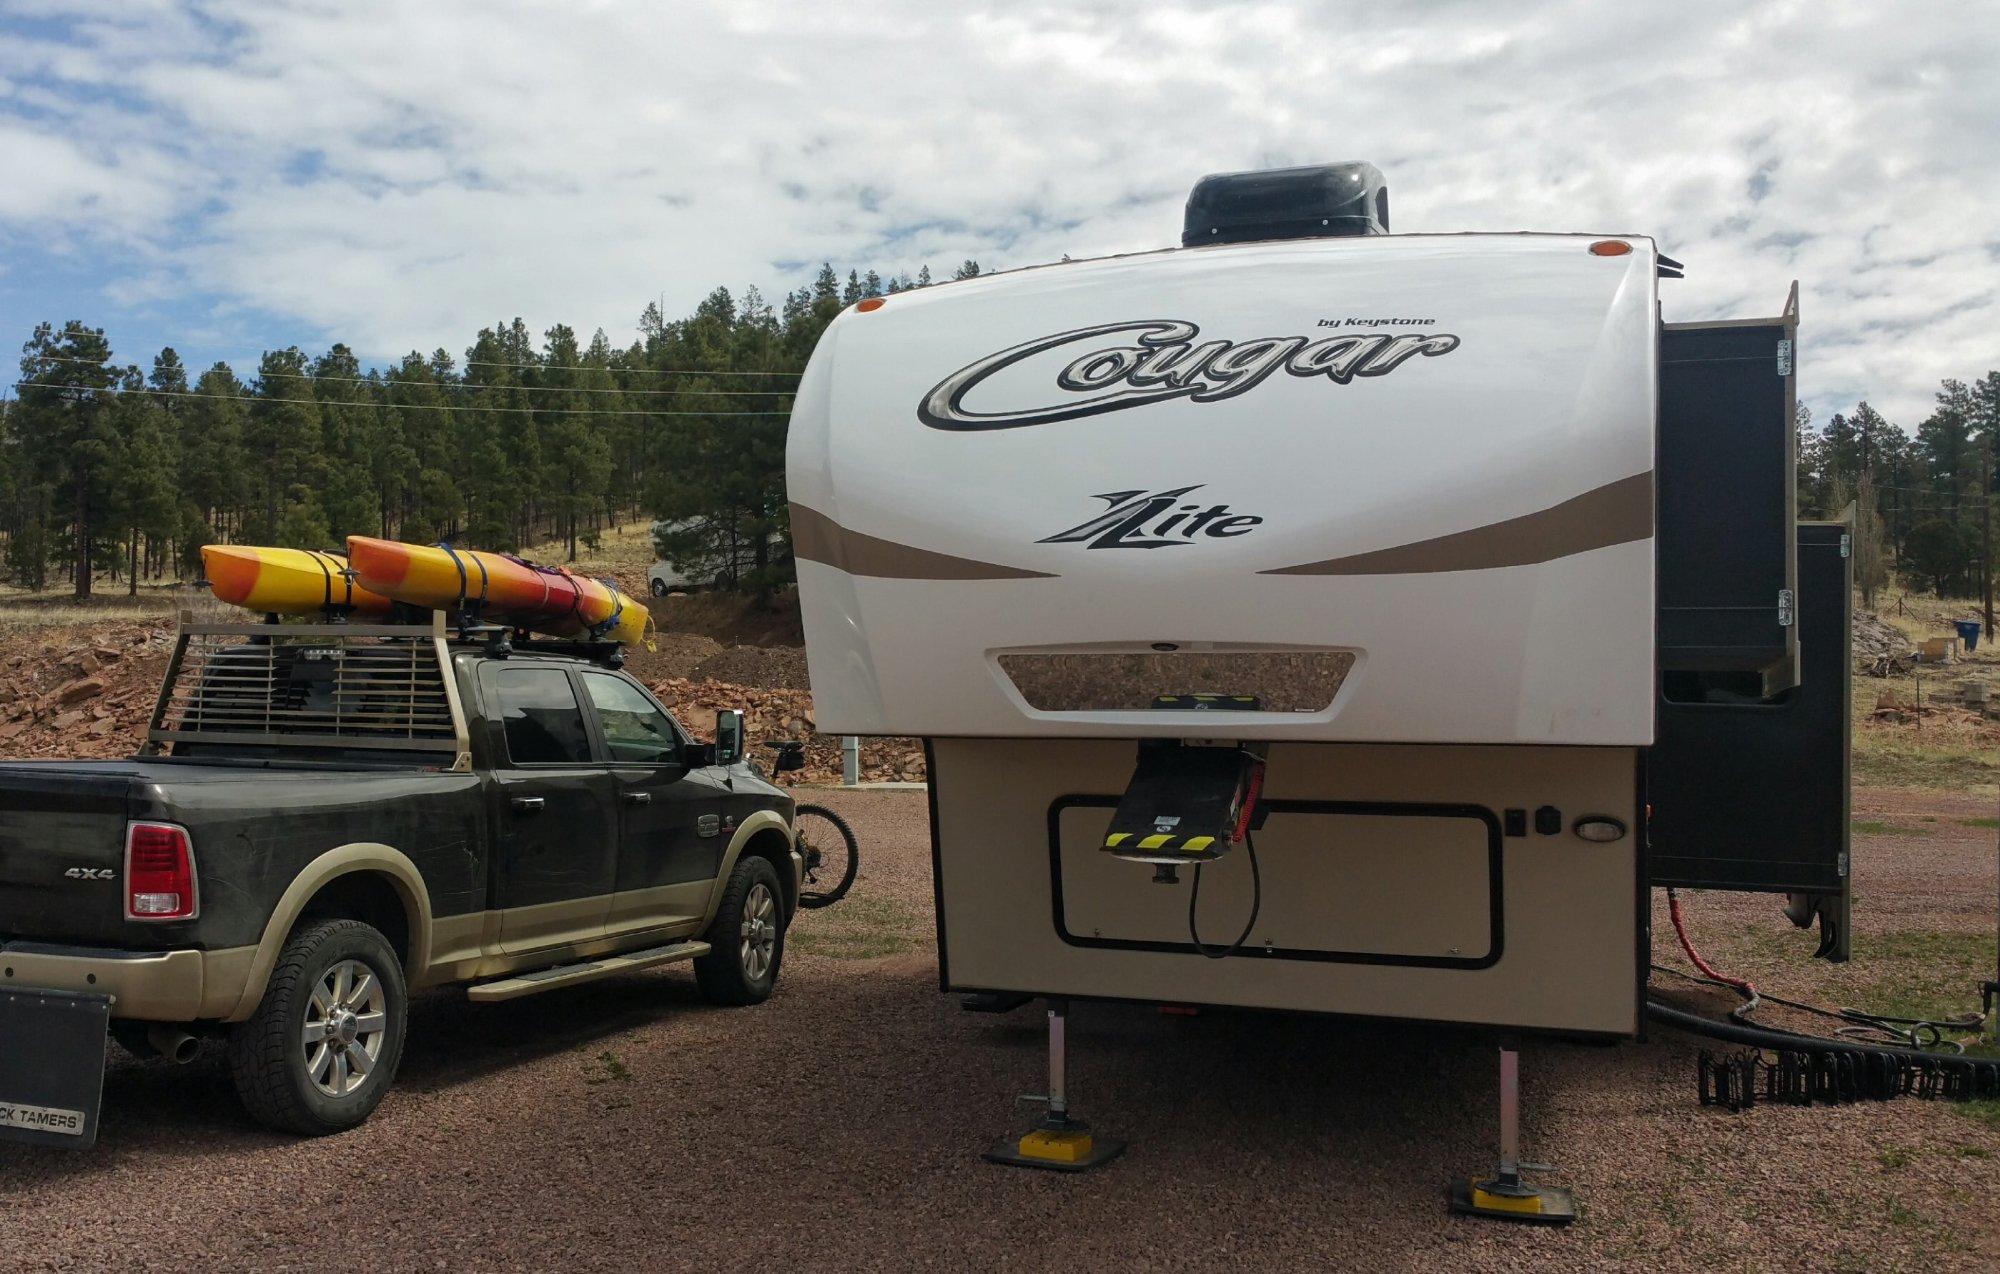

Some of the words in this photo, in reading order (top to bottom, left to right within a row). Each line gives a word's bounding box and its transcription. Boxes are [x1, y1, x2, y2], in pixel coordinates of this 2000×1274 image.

[1317, 318, 1341, 329] by
[1344, 317, 1436, 328] Keystone
[917, 319, 1461, 431] Cougar
[20, 1110, 77, 1128] TAMERS
